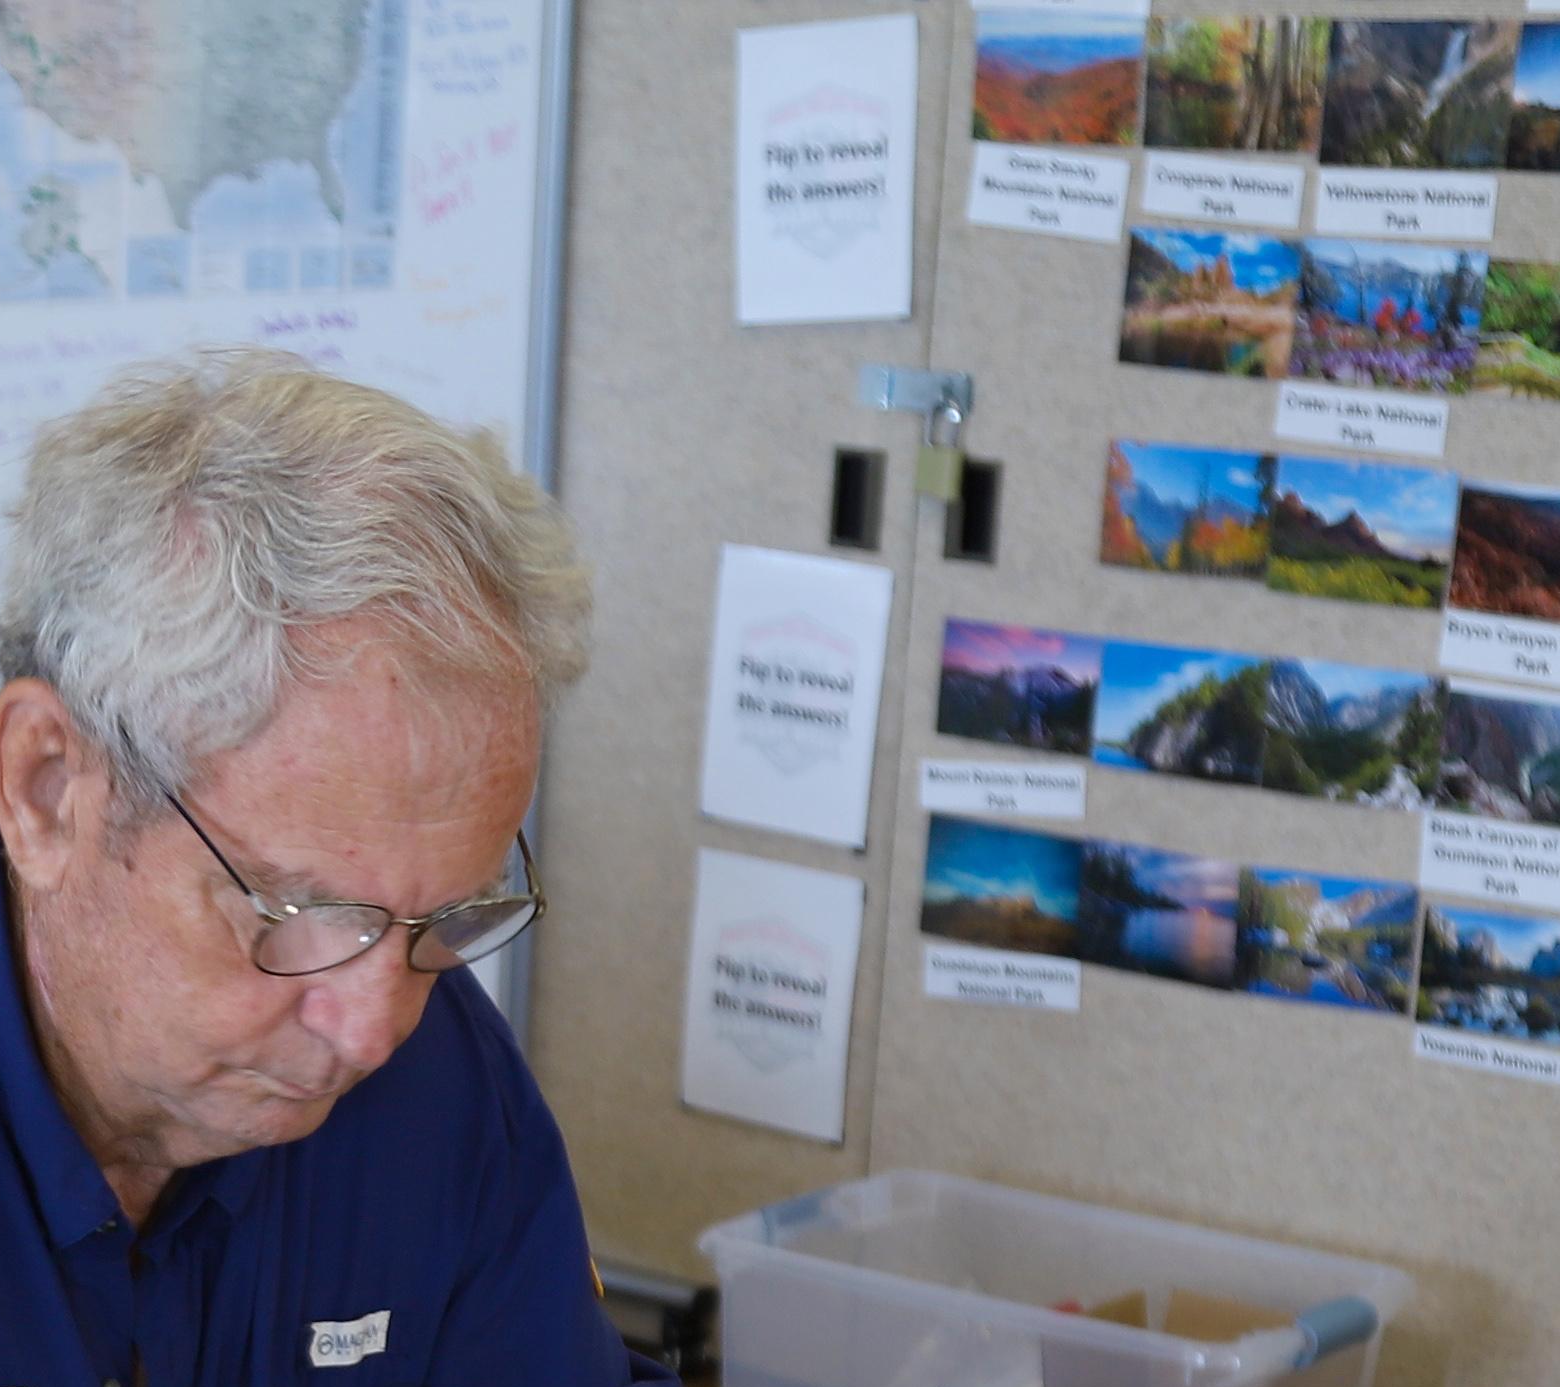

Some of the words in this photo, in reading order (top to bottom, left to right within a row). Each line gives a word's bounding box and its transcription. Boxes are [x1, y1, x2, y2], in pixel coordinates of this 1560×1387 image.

[765, 142, 797, 170] Flip
[804, 143, 824, 161] to
[830, 134, 888, 160] reveal
[766, 182, 794, 201] the
[801, 176, 885, 200] answers!
[1231, 176, 1293, 198] National
[1325, 183, 1419, 203] Yellowstone
[1425, 189, 1491, 207] National
[1202, 197, 1237, 216] Park
[1386, 211, 1421, 230] Park
[1336, 401, 1373, 417] Lake
[1377, 405, 1443, 428] National
[1341, 422, 1376, 445] Park
[1447, 618, 1494, 640] Bryce
[1498, 625, 1558, 652] Canyon
[739, 655, 770, 684] Flip
[775, 664, 794, 682] to
[799, 669, 854, 693] reveal
[1514, 655, 1551, 676] Park
[737, 691, 763, 712] the
[770, 700, 848, 728] answers!
[1024, 773, 1080, 789] National
[1430, 819, 1472, 839] Black
[1477, 826, 1538, 851] Canyon
[1542, 834, 1558, 848] of
[1434, 844, 1509, 869] Gunnison
[1484, 876, 1519, 896] Park
[715, 955, 746, 982] Flip
[750, 963, 768, 982] to
[772, 971, 827, 998] reveal
[957, 980, 1012, 999] National
[1015, 985, 1045, 1002] Park
[714, 989, 741, 1009] the
[745, 1000, 821, 1030] answers!
[1420, 1034, 1485, 1060] Yosemite
[1492, 1048, 1557, 1075] National
